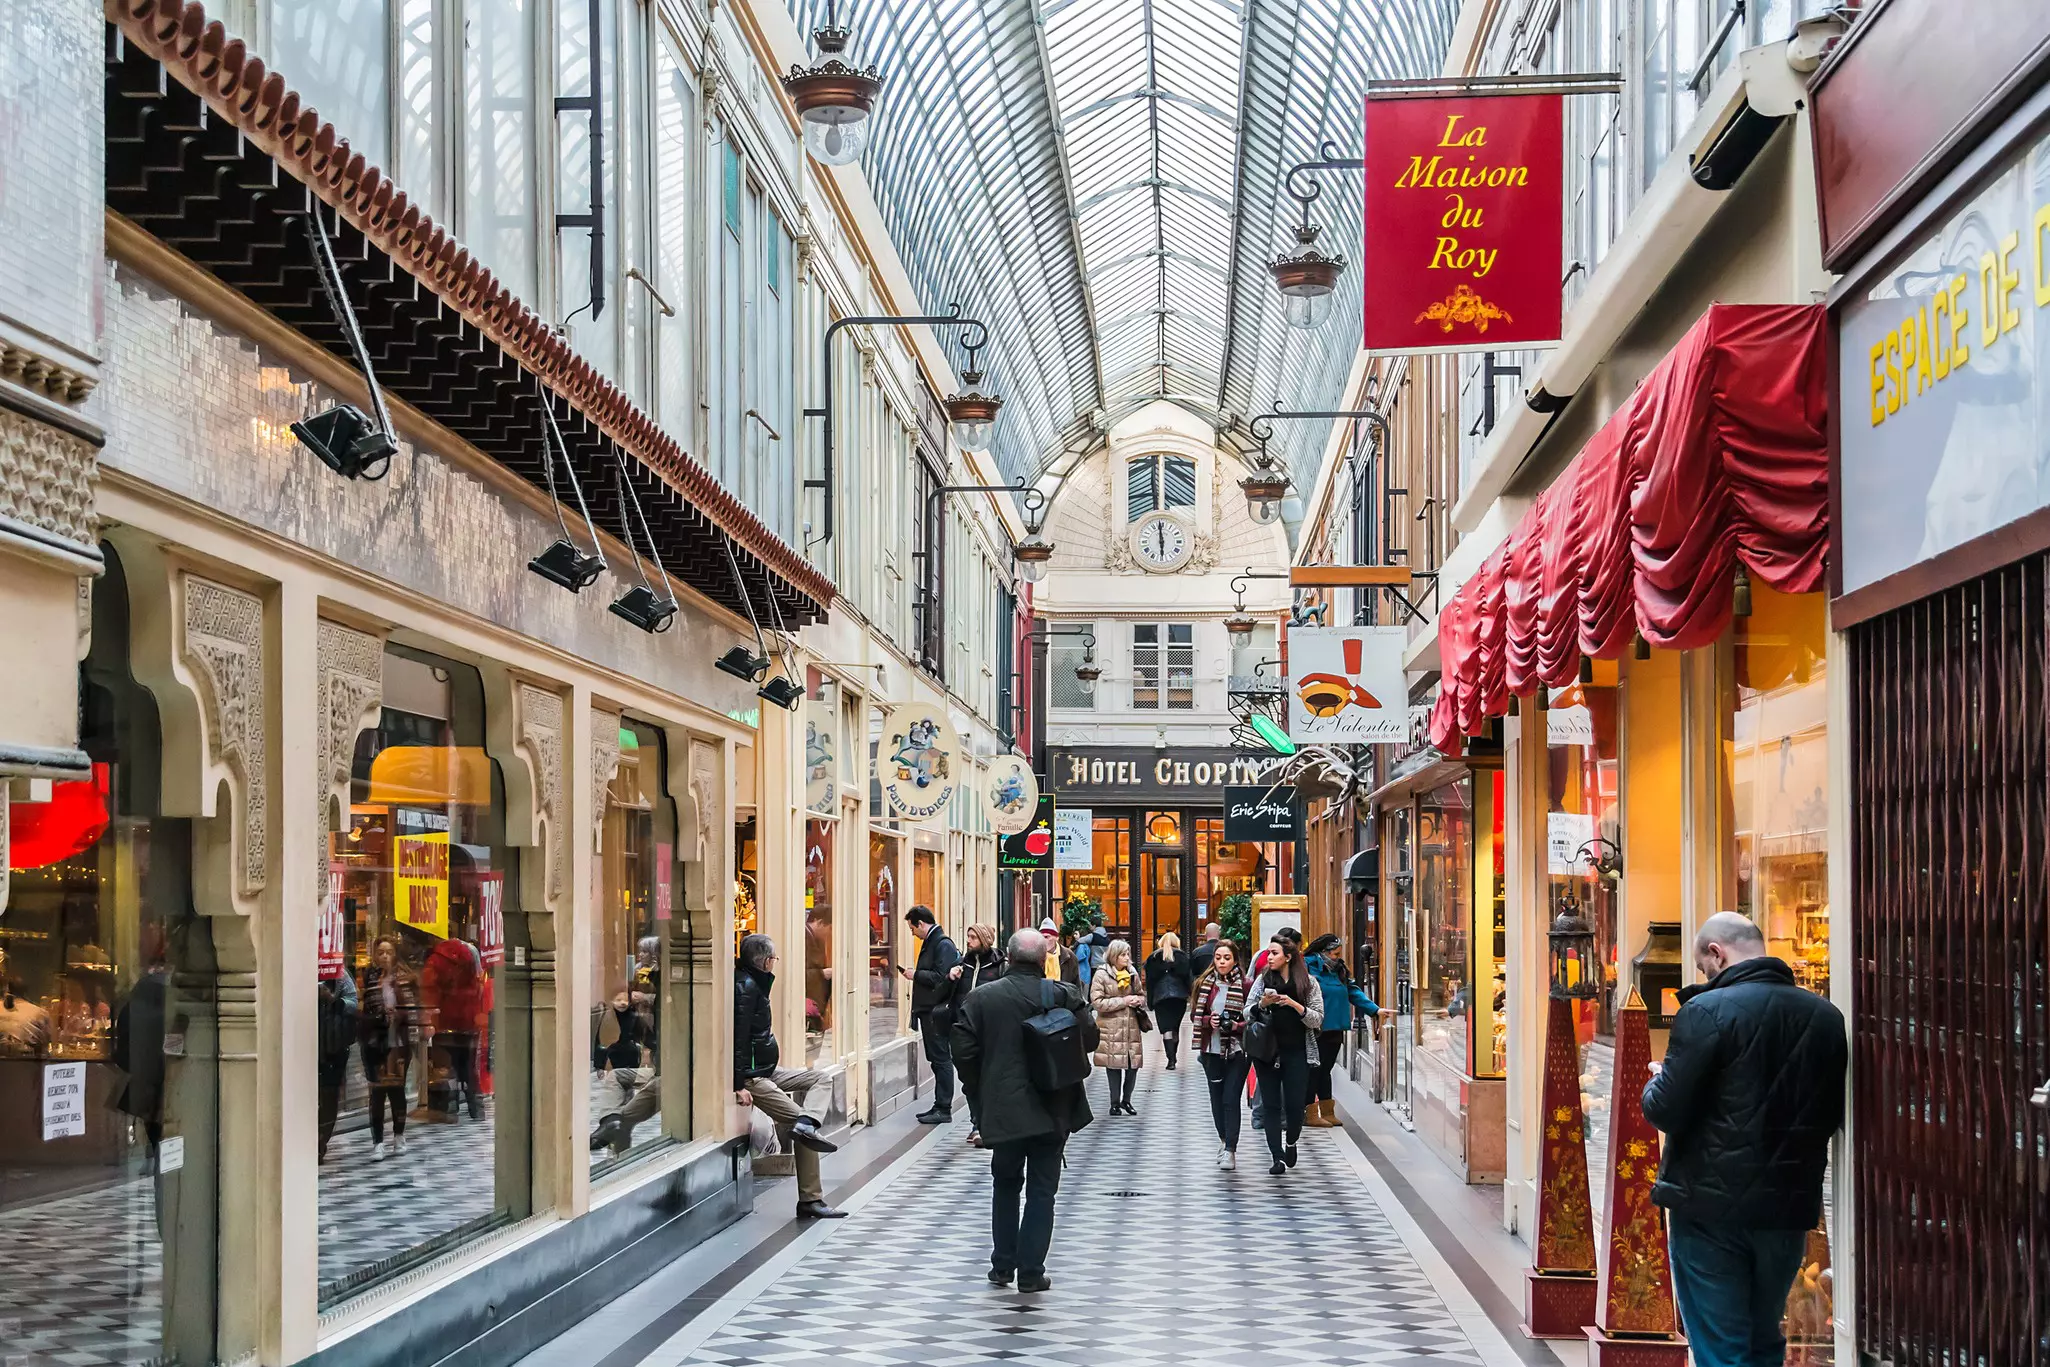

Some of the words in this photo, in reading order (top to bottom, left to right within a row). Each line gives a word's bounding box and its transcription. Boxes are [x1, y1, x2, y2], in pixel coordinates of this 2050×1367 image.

[1437, 115, 1488, 147] La
[1394, 155, 1529, 188] Maison
[1441, 193, 1484, 228] du
[1426, 236, 1498, 278] Roy
[1869, 272, 1969, 428] ESPACE
[1980, 229, 2020, 349] DE
[1327, 714, 1401, 733] Valentin
[1361, 732, 1380, 740] Salon
[1381, 731, 1390, 739] de
[1230, 802, 1254, 818] Eric
[1252, 800, 1292, 824] Stipa
[1002, 853, 1039, 865] Librairie
[408, 885, 439, 924] MASSIF
